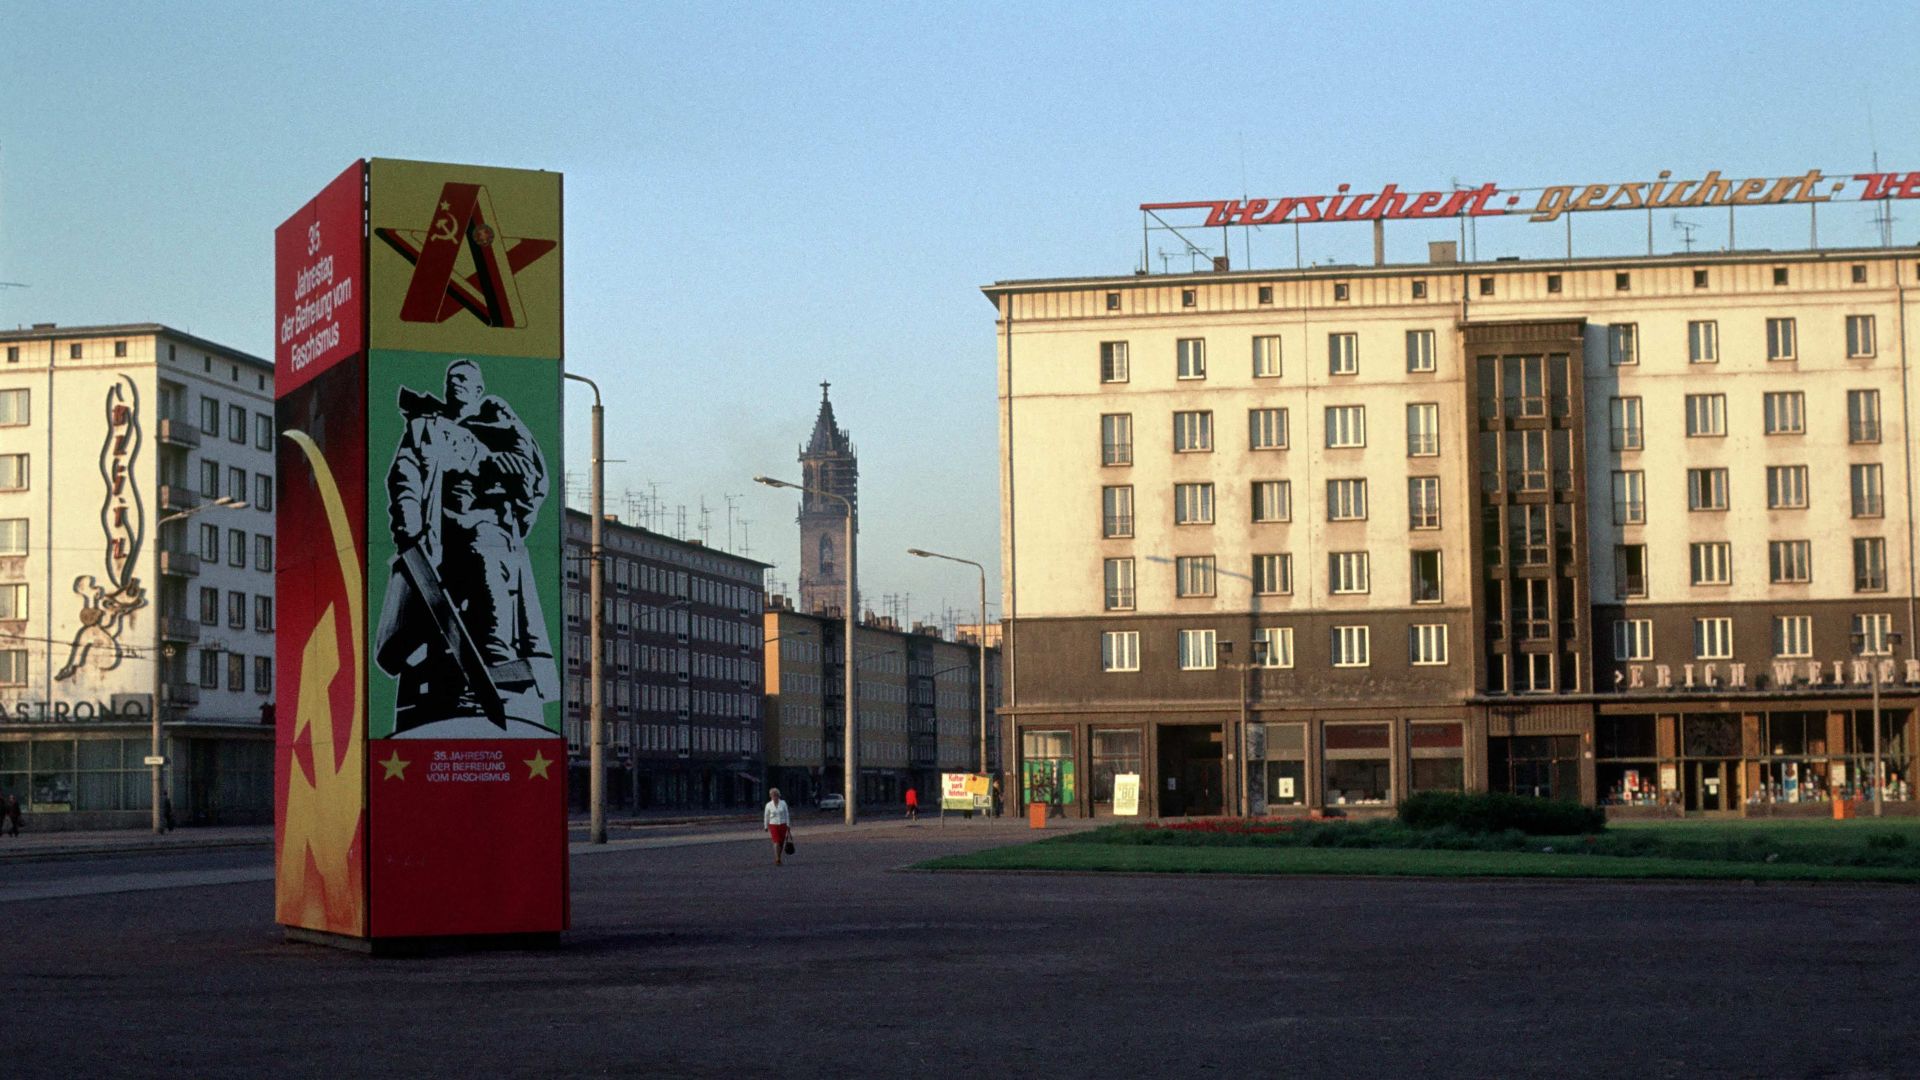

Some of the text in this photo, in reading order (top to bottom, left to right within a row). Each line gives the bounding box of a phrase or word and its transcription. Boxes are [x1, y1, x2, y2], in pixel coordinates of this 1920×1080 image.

[295, 255, 333, 301] Jahrestag
[281, 277, 352, 344] der Befreiung vom
[291, 321, 340, 373] Faschismus
[430, 761, 506, 771] DER BEFREIUNG
[433, 751, 503, 761] 35. JAHRESTAG
[426, 772, 511, 782] VOM FASCHISMUS
